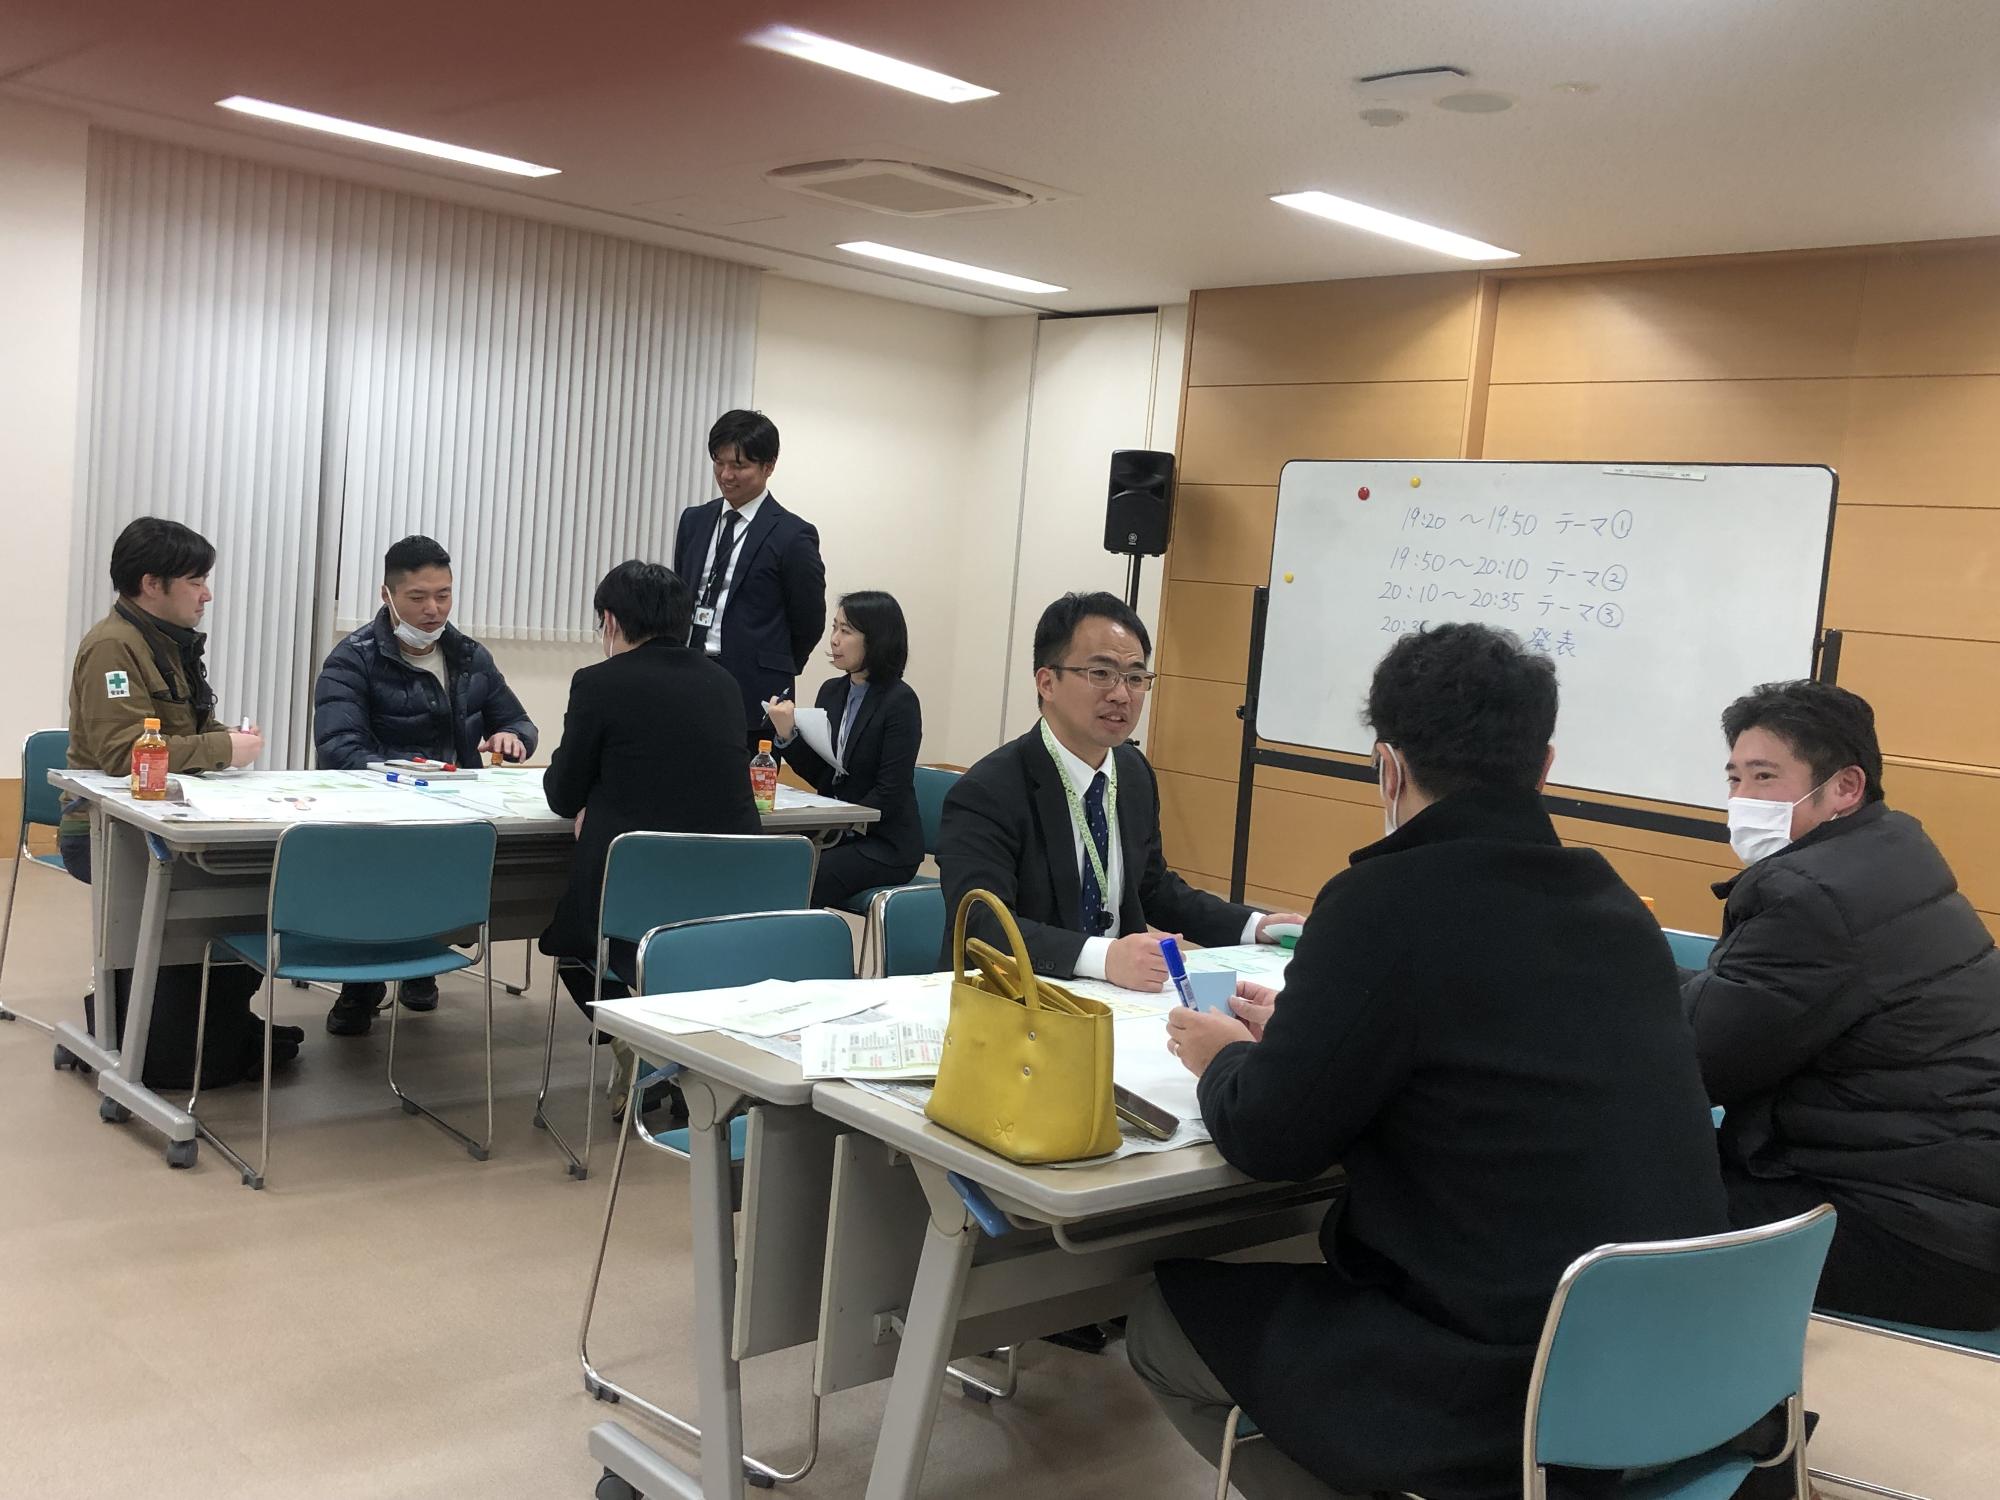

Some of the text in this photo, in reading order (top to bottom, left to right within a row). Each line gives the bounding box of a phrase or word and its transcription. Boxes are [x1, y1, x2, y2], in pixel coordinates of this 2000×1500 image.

[1555, 509, 1633, 539] テーマ①
[1547, 561, 1628, 592] テーマ②
[1537, 594, 1625, 628] テーマ③
[1526, 627, 1577, 657] 発表
